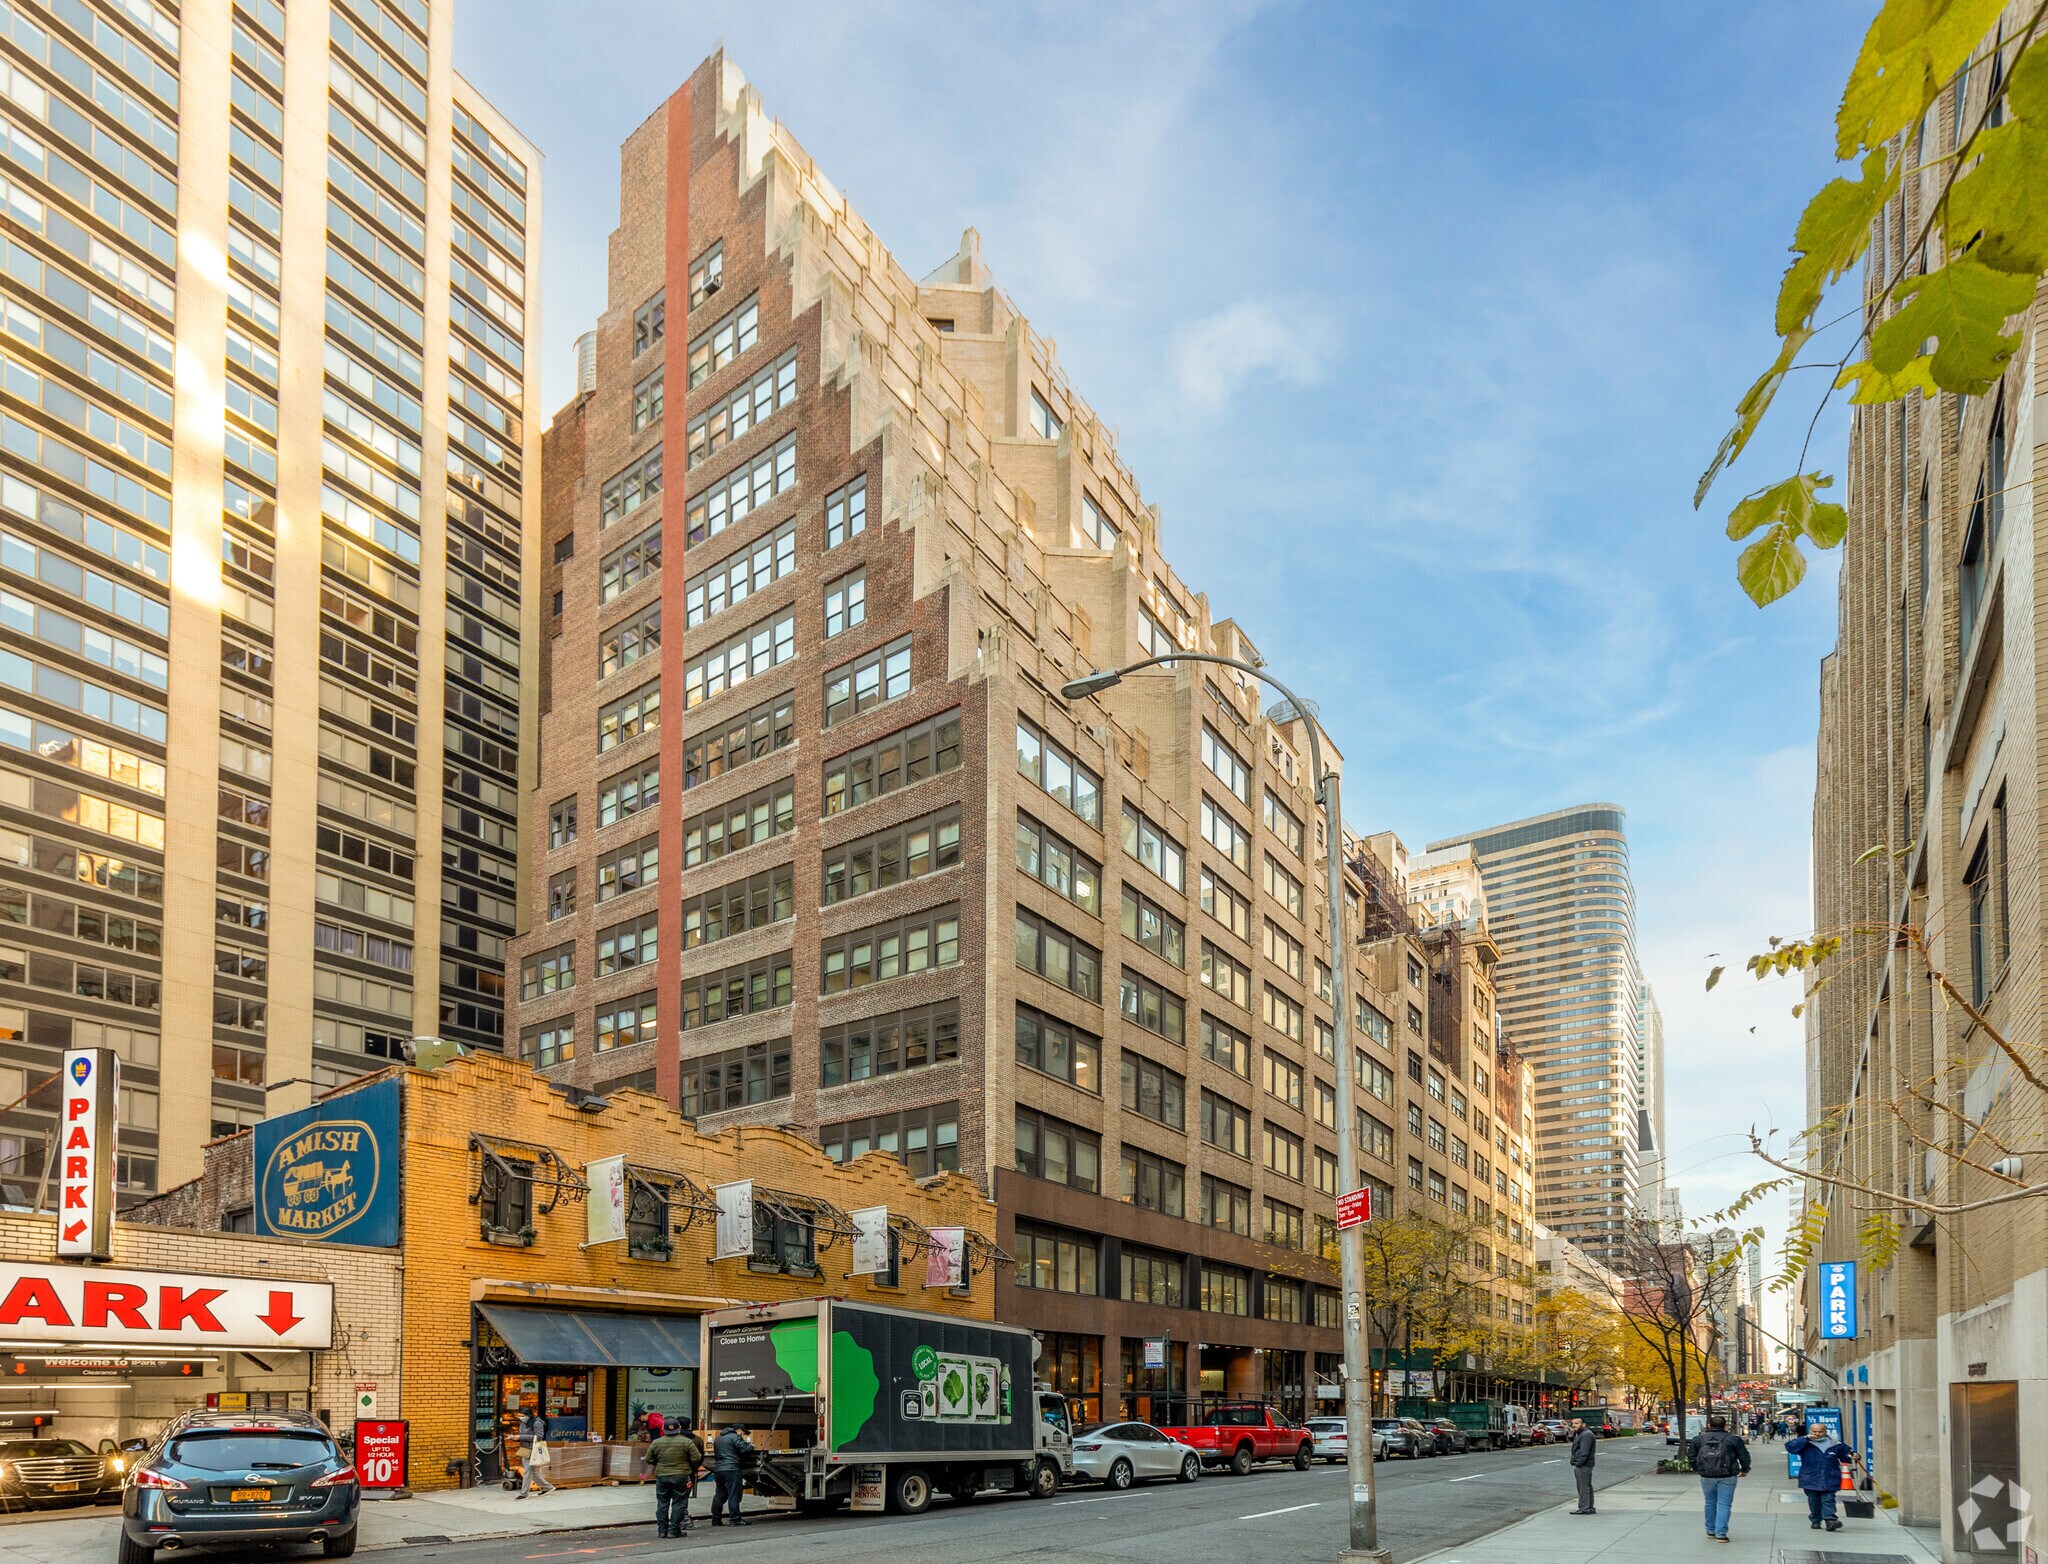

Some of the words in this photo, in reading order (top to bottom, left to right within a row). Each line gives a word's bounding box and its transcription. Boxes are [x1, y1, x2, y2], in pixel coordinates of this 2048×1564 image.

[65, 1098, 90, 1209] PARK
[278, 1131, 361, 1172] AMISH
[278, 1192, 357, 1229] MARKET
[0, 1277, 228, 1333] ARK
[1830, 1273, 1847, 1324] PARK
[720, 1337, 738, 1345] Close
[738, 1336, 746, 1344] to
[746, 1335, 766, 1343] Home
[918, 1356, 933, 1370] LOCAL
[363, 1436, 399, 1446] Special
[551, 1429, 585, 1438] Catering
[362, 1458, 392, 1482] 10
